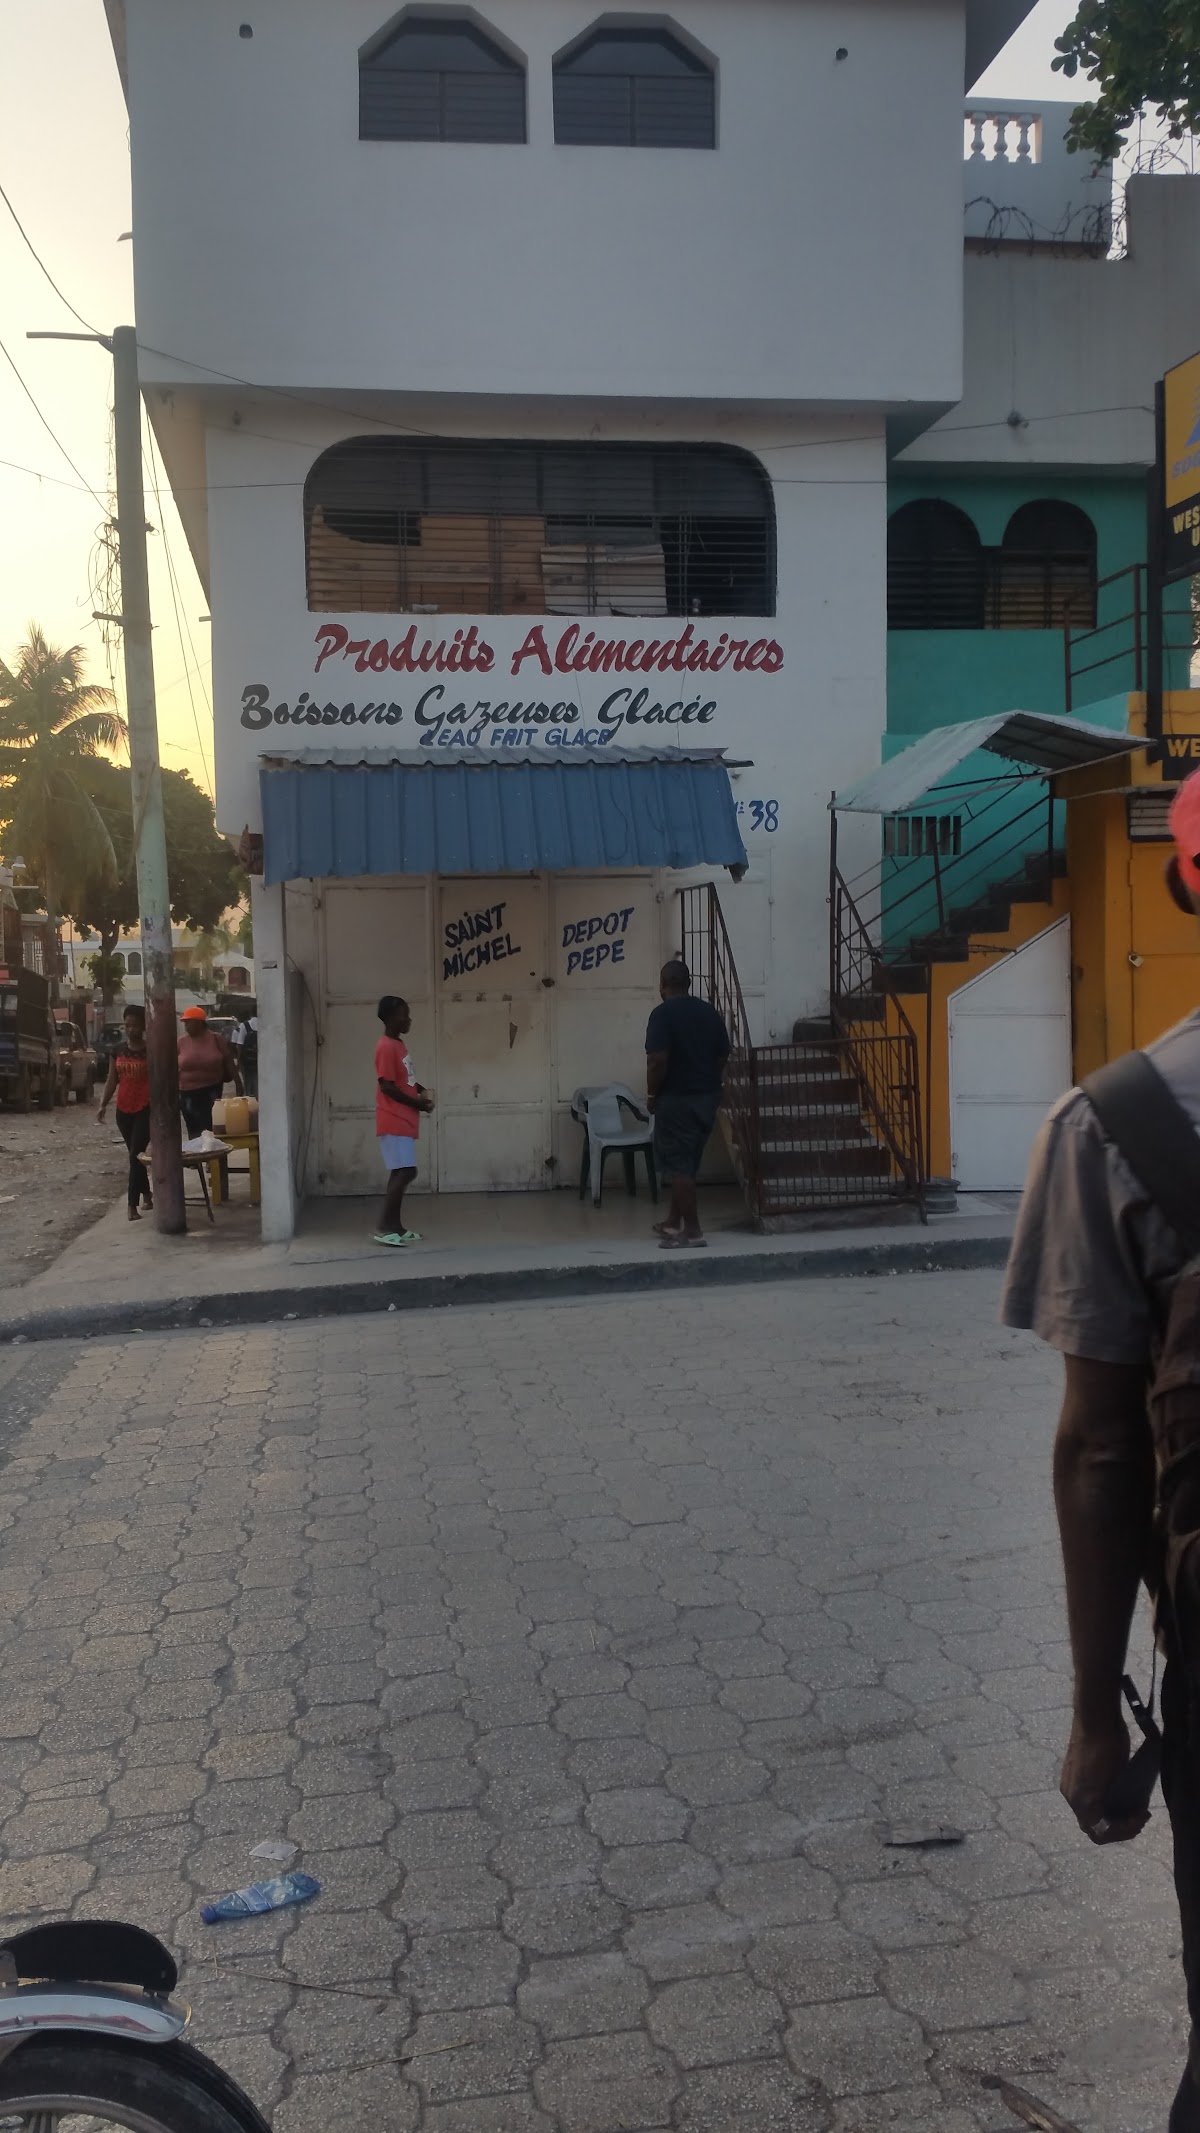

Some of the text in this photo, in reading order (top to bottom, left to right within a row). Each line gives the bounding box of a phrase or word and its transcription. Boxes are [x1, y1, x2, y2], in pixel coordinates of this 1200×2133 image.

[314, 623, 785, 676] Produits Alimentaires
[240, 683, 404, 730] Boissons
[414, 684, 581, 739] Gazeuses
[749, 799, 779, 833] 38
[444, 902, 507, 949] SAINT
[562, 907, 635, 948] DEPOT
[443, 933, 522, 981] MICHEL
[566, 939, 625, 976] PEPE
